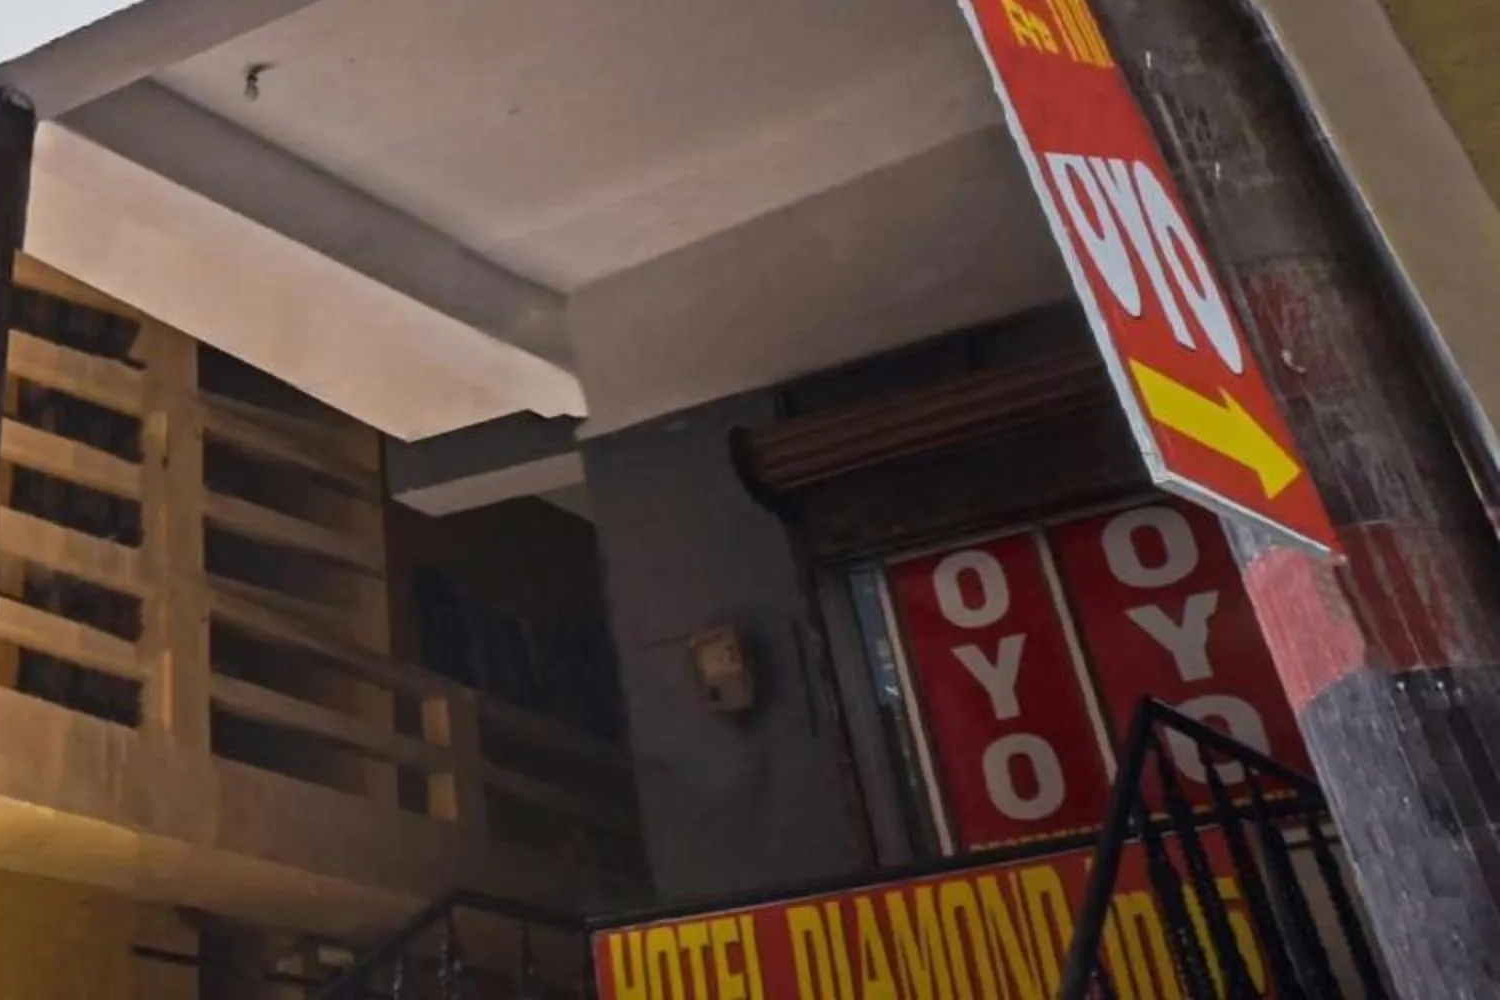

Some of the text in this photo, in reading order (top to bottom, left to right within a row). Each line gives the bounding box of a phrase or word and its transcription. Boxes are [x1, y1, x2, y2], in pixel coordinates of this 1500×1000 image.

[1044, 152, 1244, 374] OYO
[932, 549, 1066, 820] OYO
[1102, 505, 1272, 784] OYO
[609, 915, 765, 1000] HOTEL
[786, 865, 1073, 1000] DIAMOND
